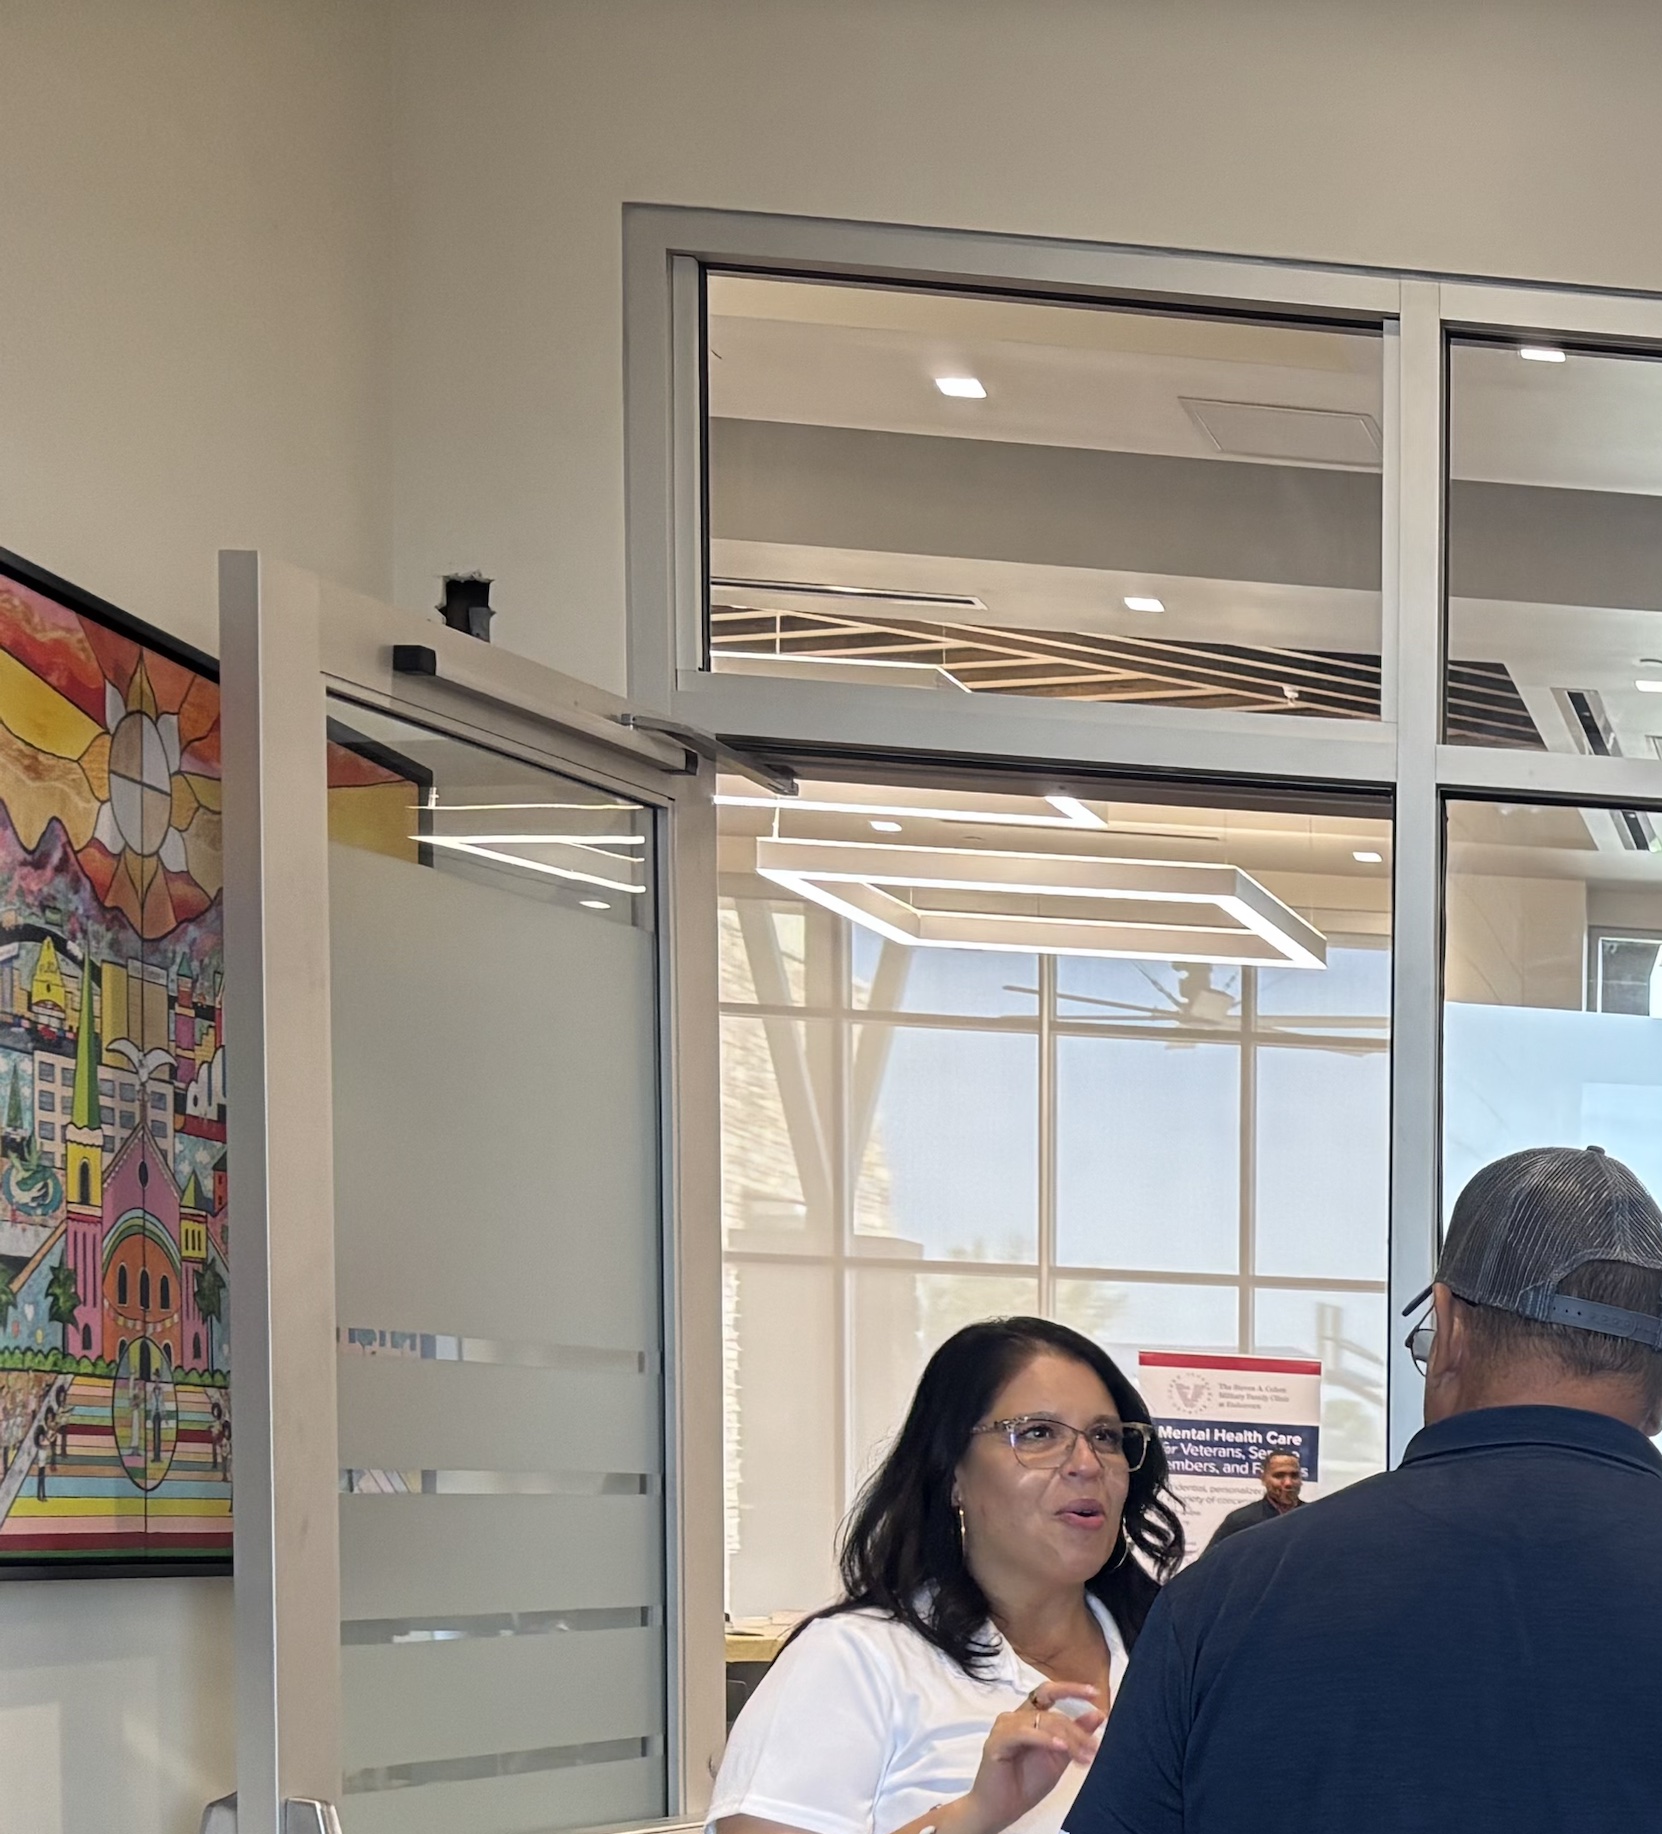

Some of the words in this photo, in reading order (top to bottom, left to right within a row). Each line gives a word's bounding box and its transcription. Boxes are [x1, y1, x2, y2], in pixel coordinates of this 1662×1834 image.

[1158, 1425, 1210, 1440] Mental
[1213, 1428, 1263, 1444] Health
[1266, 1431, 1303, 1446] Care
[1180, 1442, 1246, 1460] Veterans,
[1166, 1459, 1220, 1474] embers,
[1223, 1461, 1249, 1474] and
